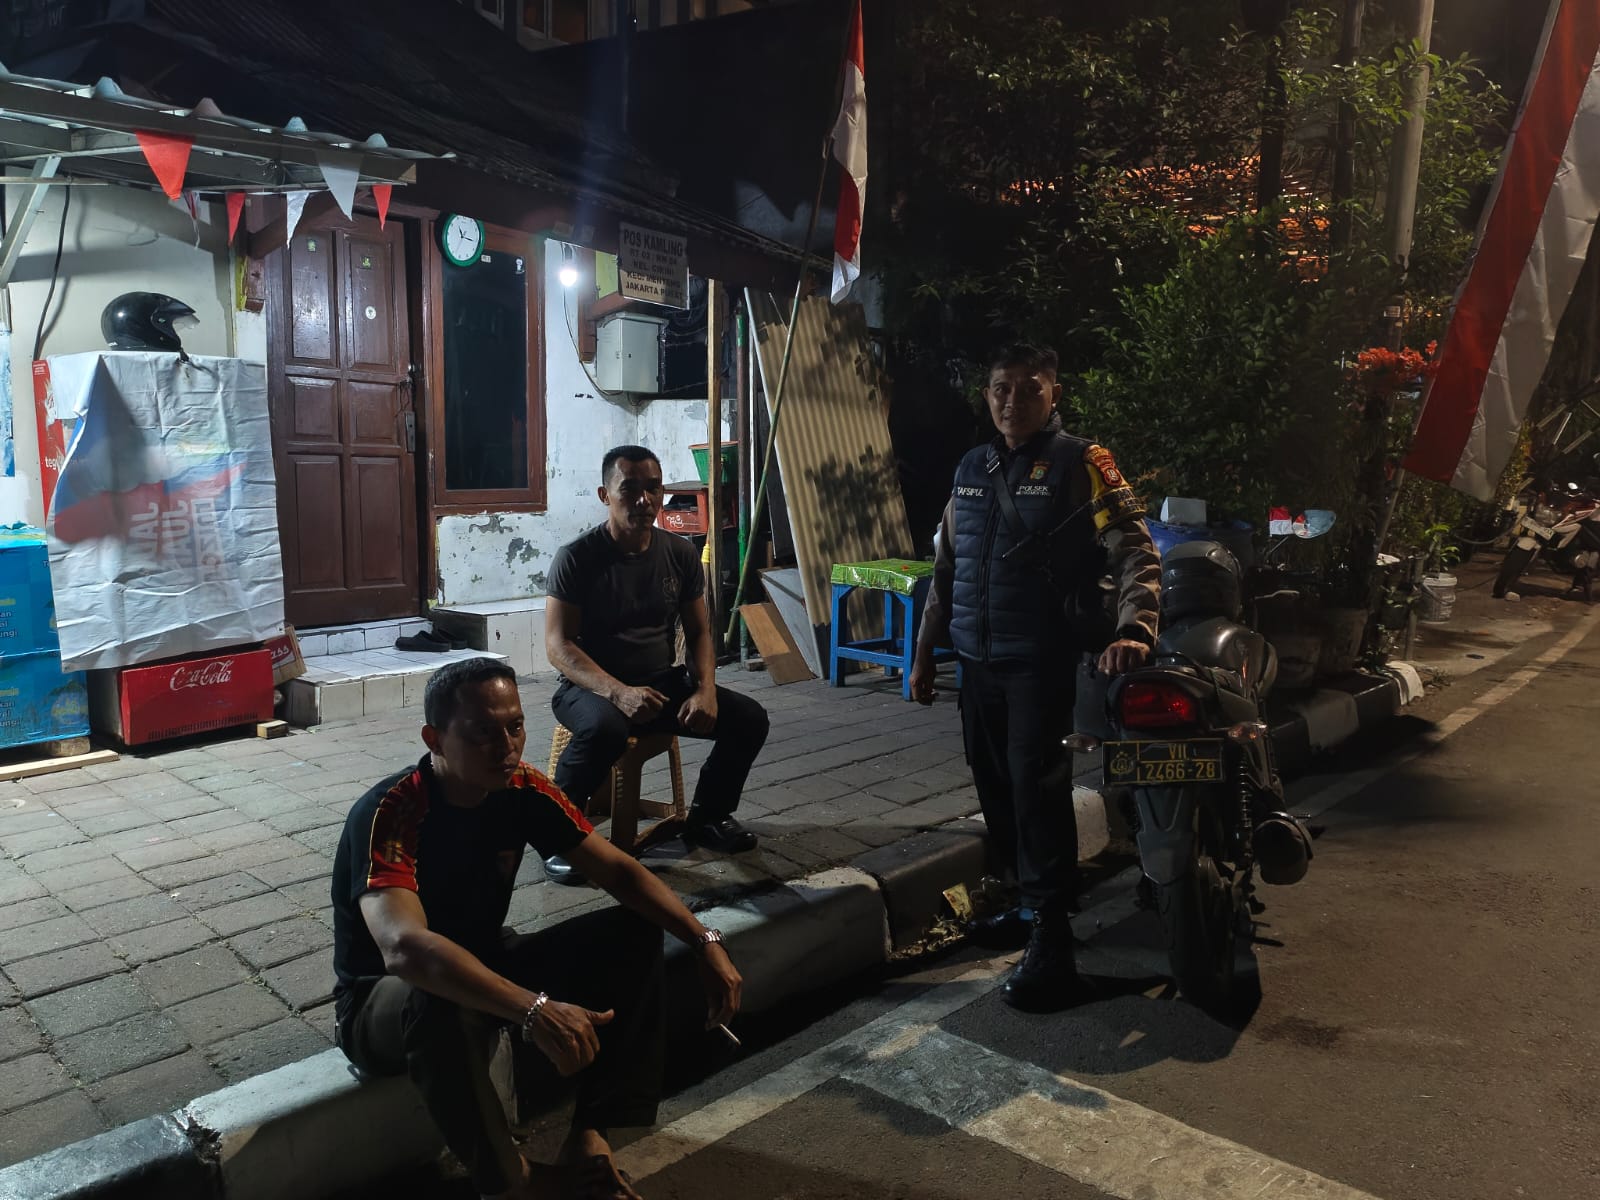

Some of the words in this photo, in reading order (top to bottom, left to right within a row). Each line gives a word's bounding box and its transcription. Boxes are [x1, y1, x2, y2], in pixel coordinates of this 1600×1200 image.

[624, 230, 641, 247] POS
[644, 235, 682, 257] KAMLING
[626, 281, 658, 294] JAKARTA
[646, 274, 680, 288] MENTENG
[1145, 762, 1216, 781] 2466-28
